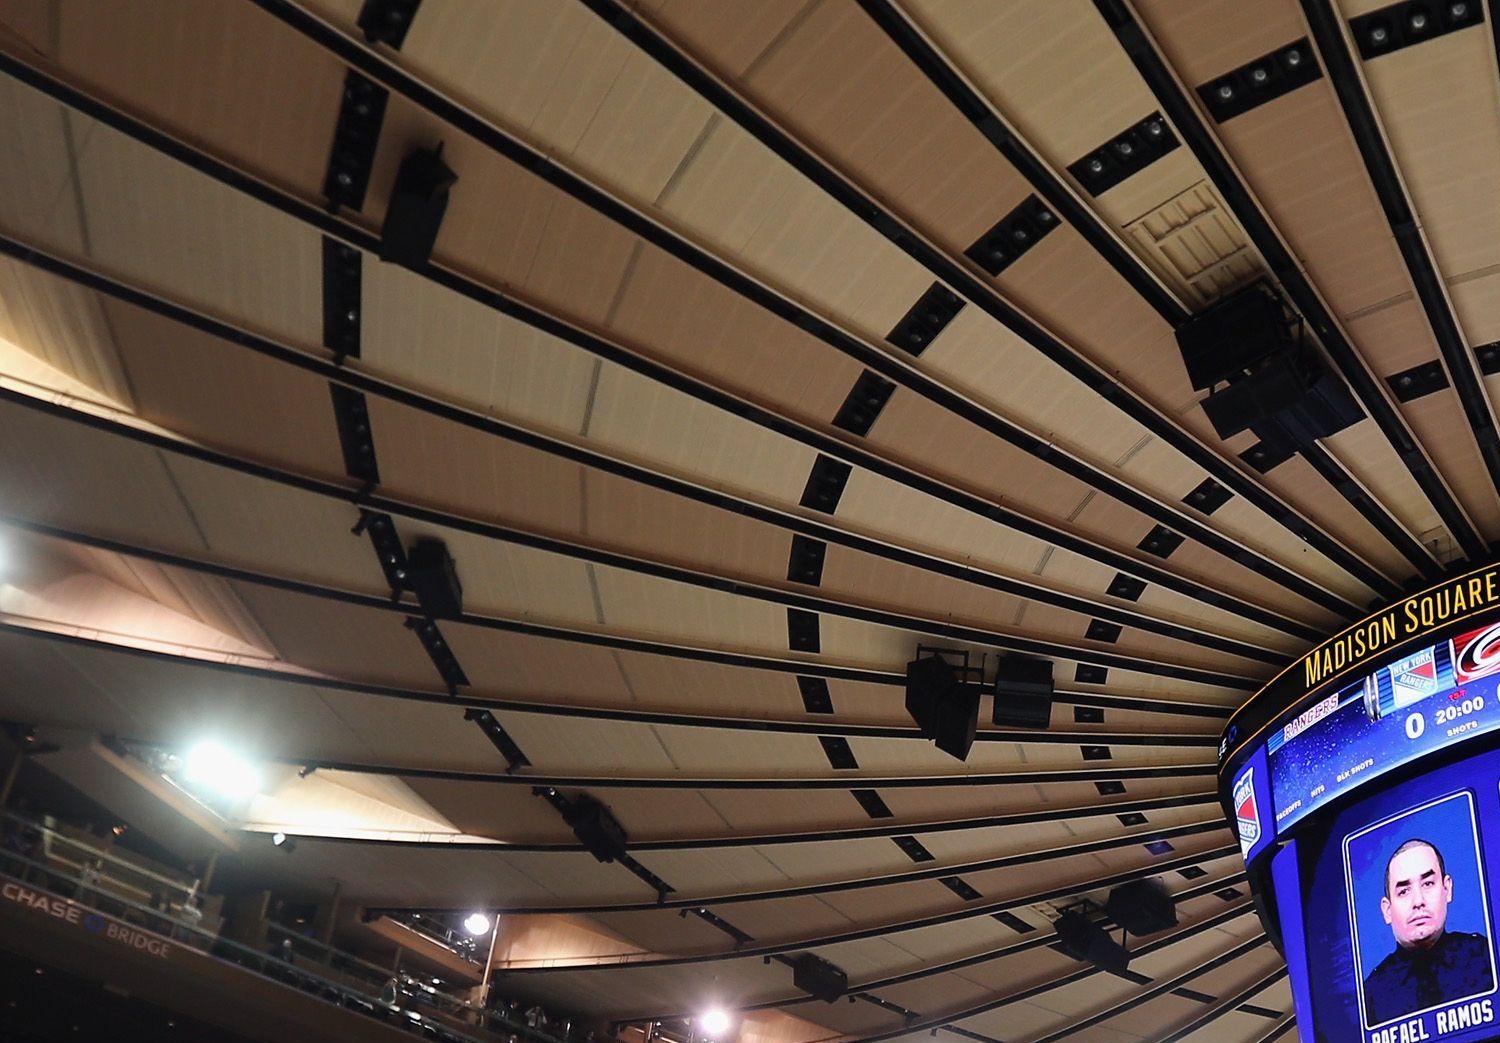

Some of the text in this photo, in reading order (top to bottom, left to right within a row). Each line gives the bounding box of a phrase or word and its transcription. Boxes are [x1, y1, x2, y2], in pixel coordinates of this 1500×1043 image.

[1305, 612, 1397, 688] MADISON
[1404, 571, 1500, 634] SQUARE
[1283, 692, 1340, 742] RANGERS
[1435, 695, 1485, 725] 20:00
[1405, 711, 1425, 740] 0
[1446, 719, 1479, 737] SHOTS
[1336, 757, 1375, 783] BLK SHOTS
[1275, 799, 1302, 822] FACEOFFS
[2, 881, 170, 960] CHASE BRIDGE
[1436, 999, 1494, 1035] RAMOS
